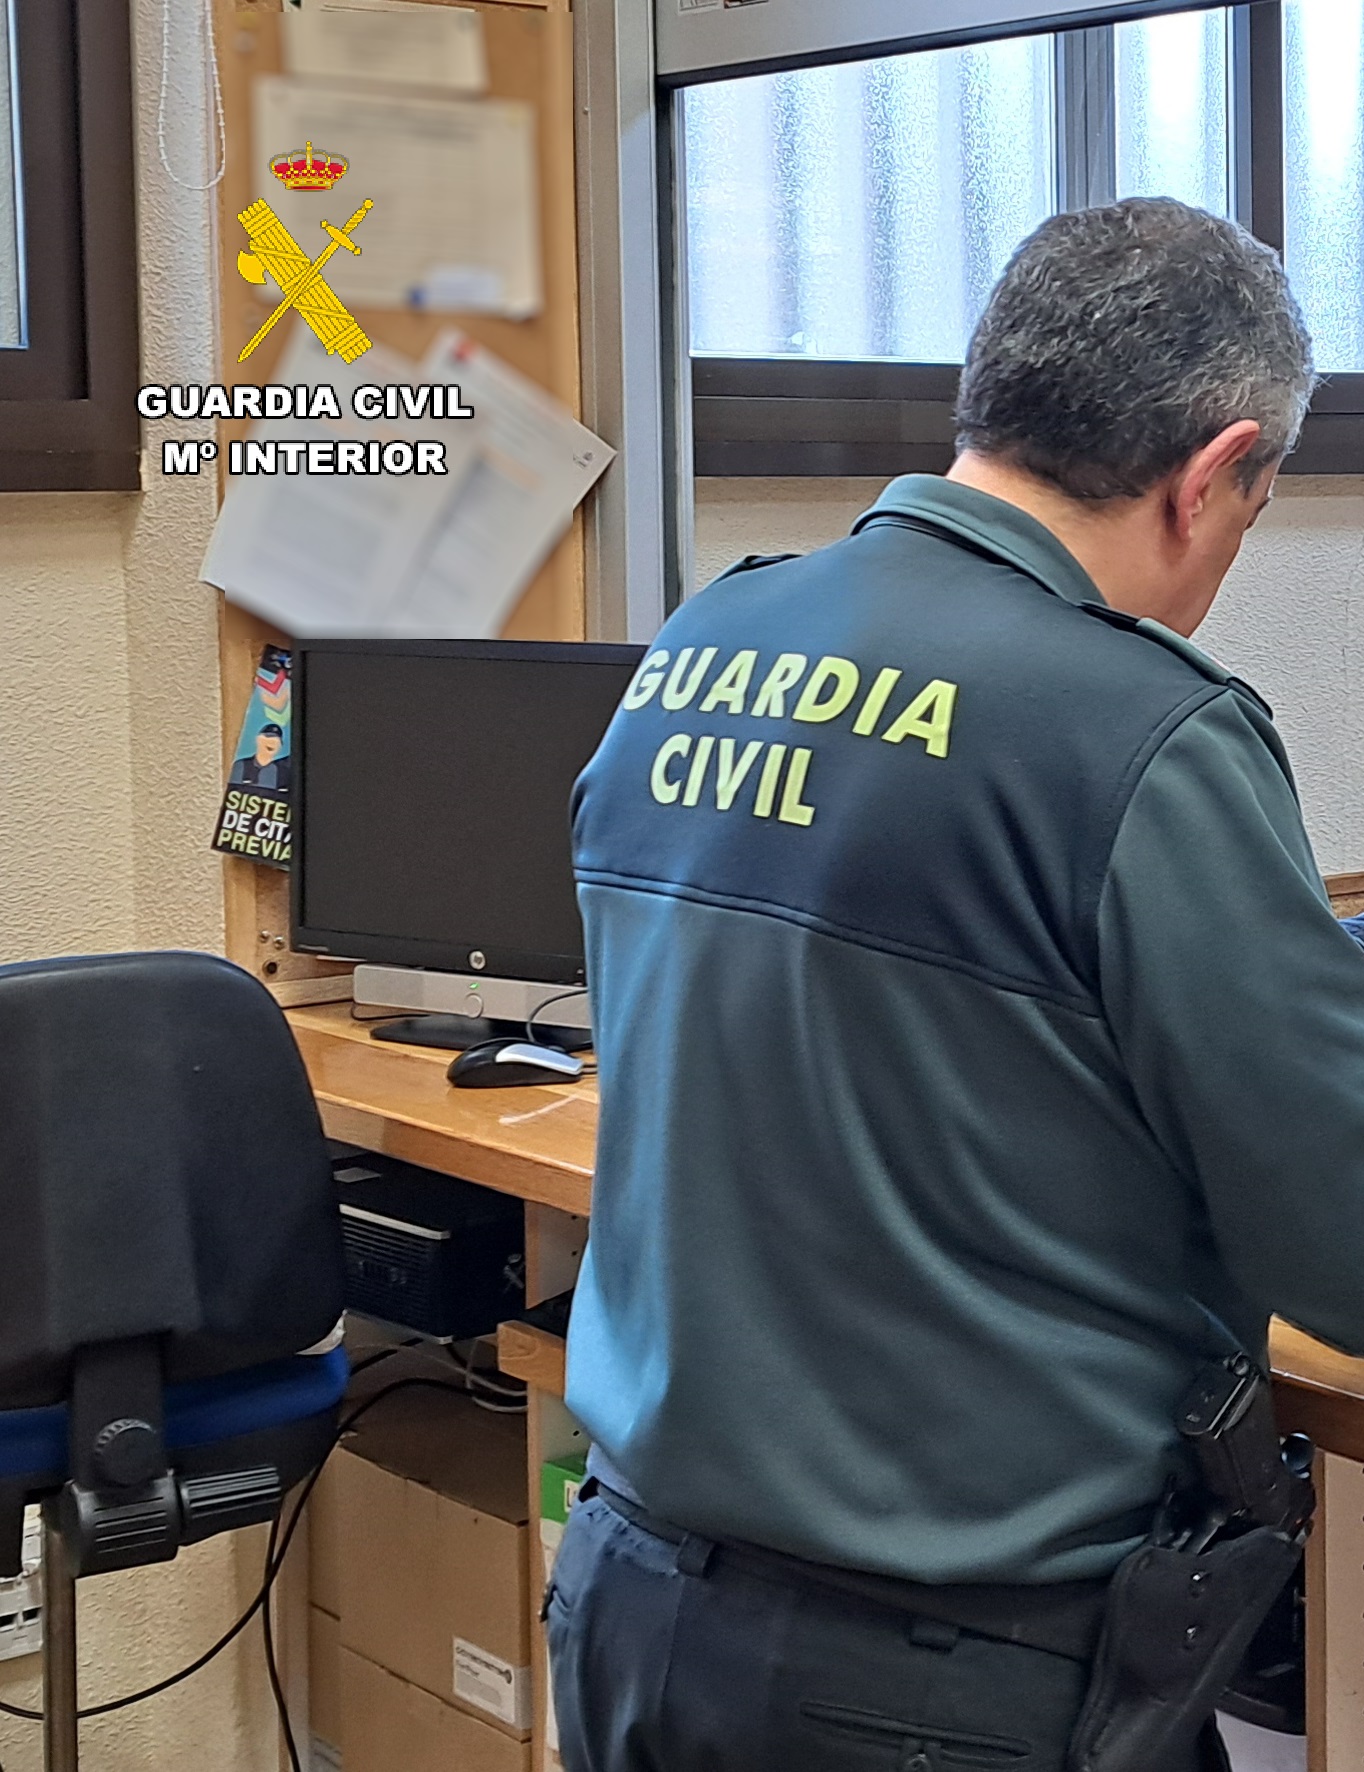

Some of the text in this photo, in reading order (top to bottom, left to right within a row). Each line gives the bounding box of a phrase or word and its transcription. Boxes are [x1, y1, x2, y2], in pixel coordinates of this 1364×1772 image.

[623, 647, 957, 758] GUARDIA
[651, 734, 815, 826] CIVIL
[216, 828, 291, 861] PREVIA
[222, 809, 252, 833] DE
